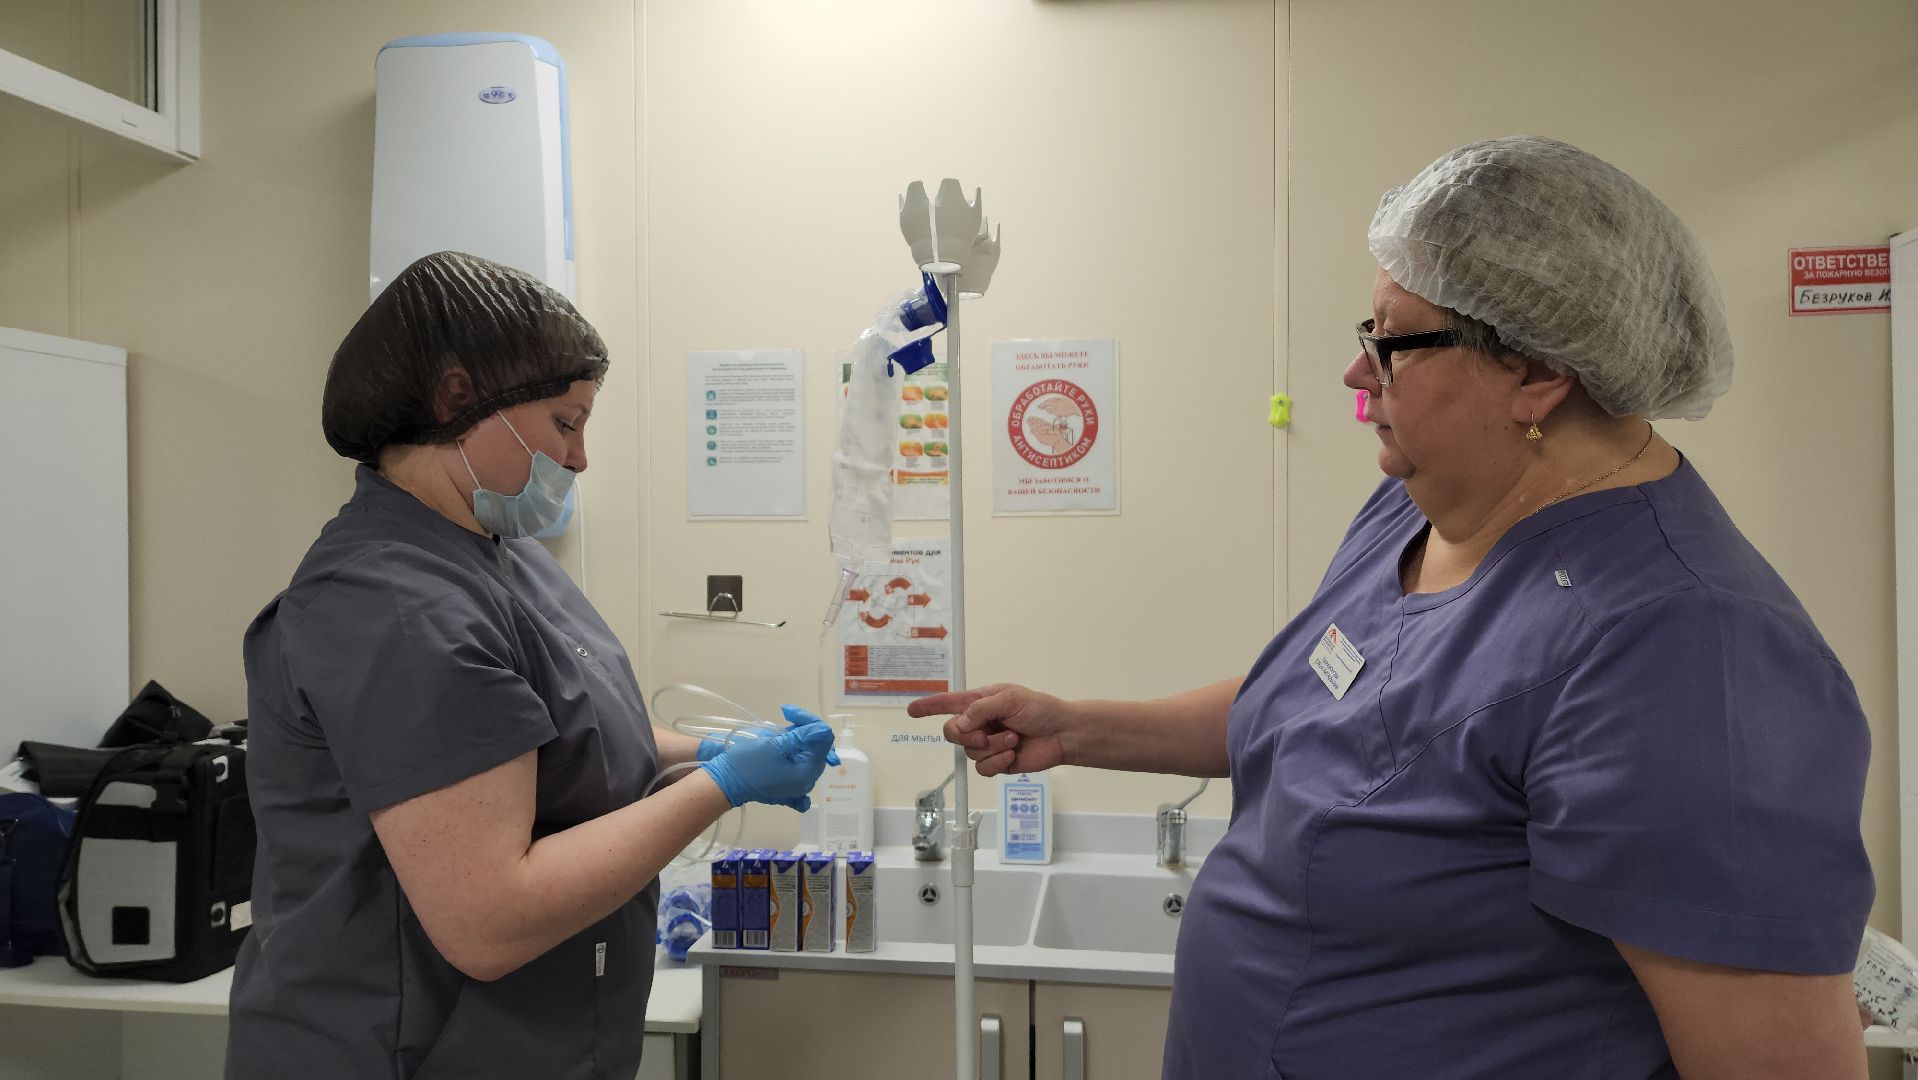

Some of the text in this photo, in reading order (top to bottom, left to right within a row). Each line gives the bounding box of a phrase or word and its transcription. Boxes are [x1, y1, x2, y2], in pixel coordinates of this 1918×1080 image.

[1794, 253, 1888, 270] ОТВЕТСТВЕ
[1804, 271, 1815, 279] ЗА
[1816, 269, 1863, 279] ПОЖАРНУЮ
[1011, 381, 1096, 428] ОБРАБОТАЙТЕ РУКИ
[1013, 435, 1091, 468] АНТИСЕПТИКОМ
[1038, 486, 1101, 494] БЕЗОПАСНОСТИ
